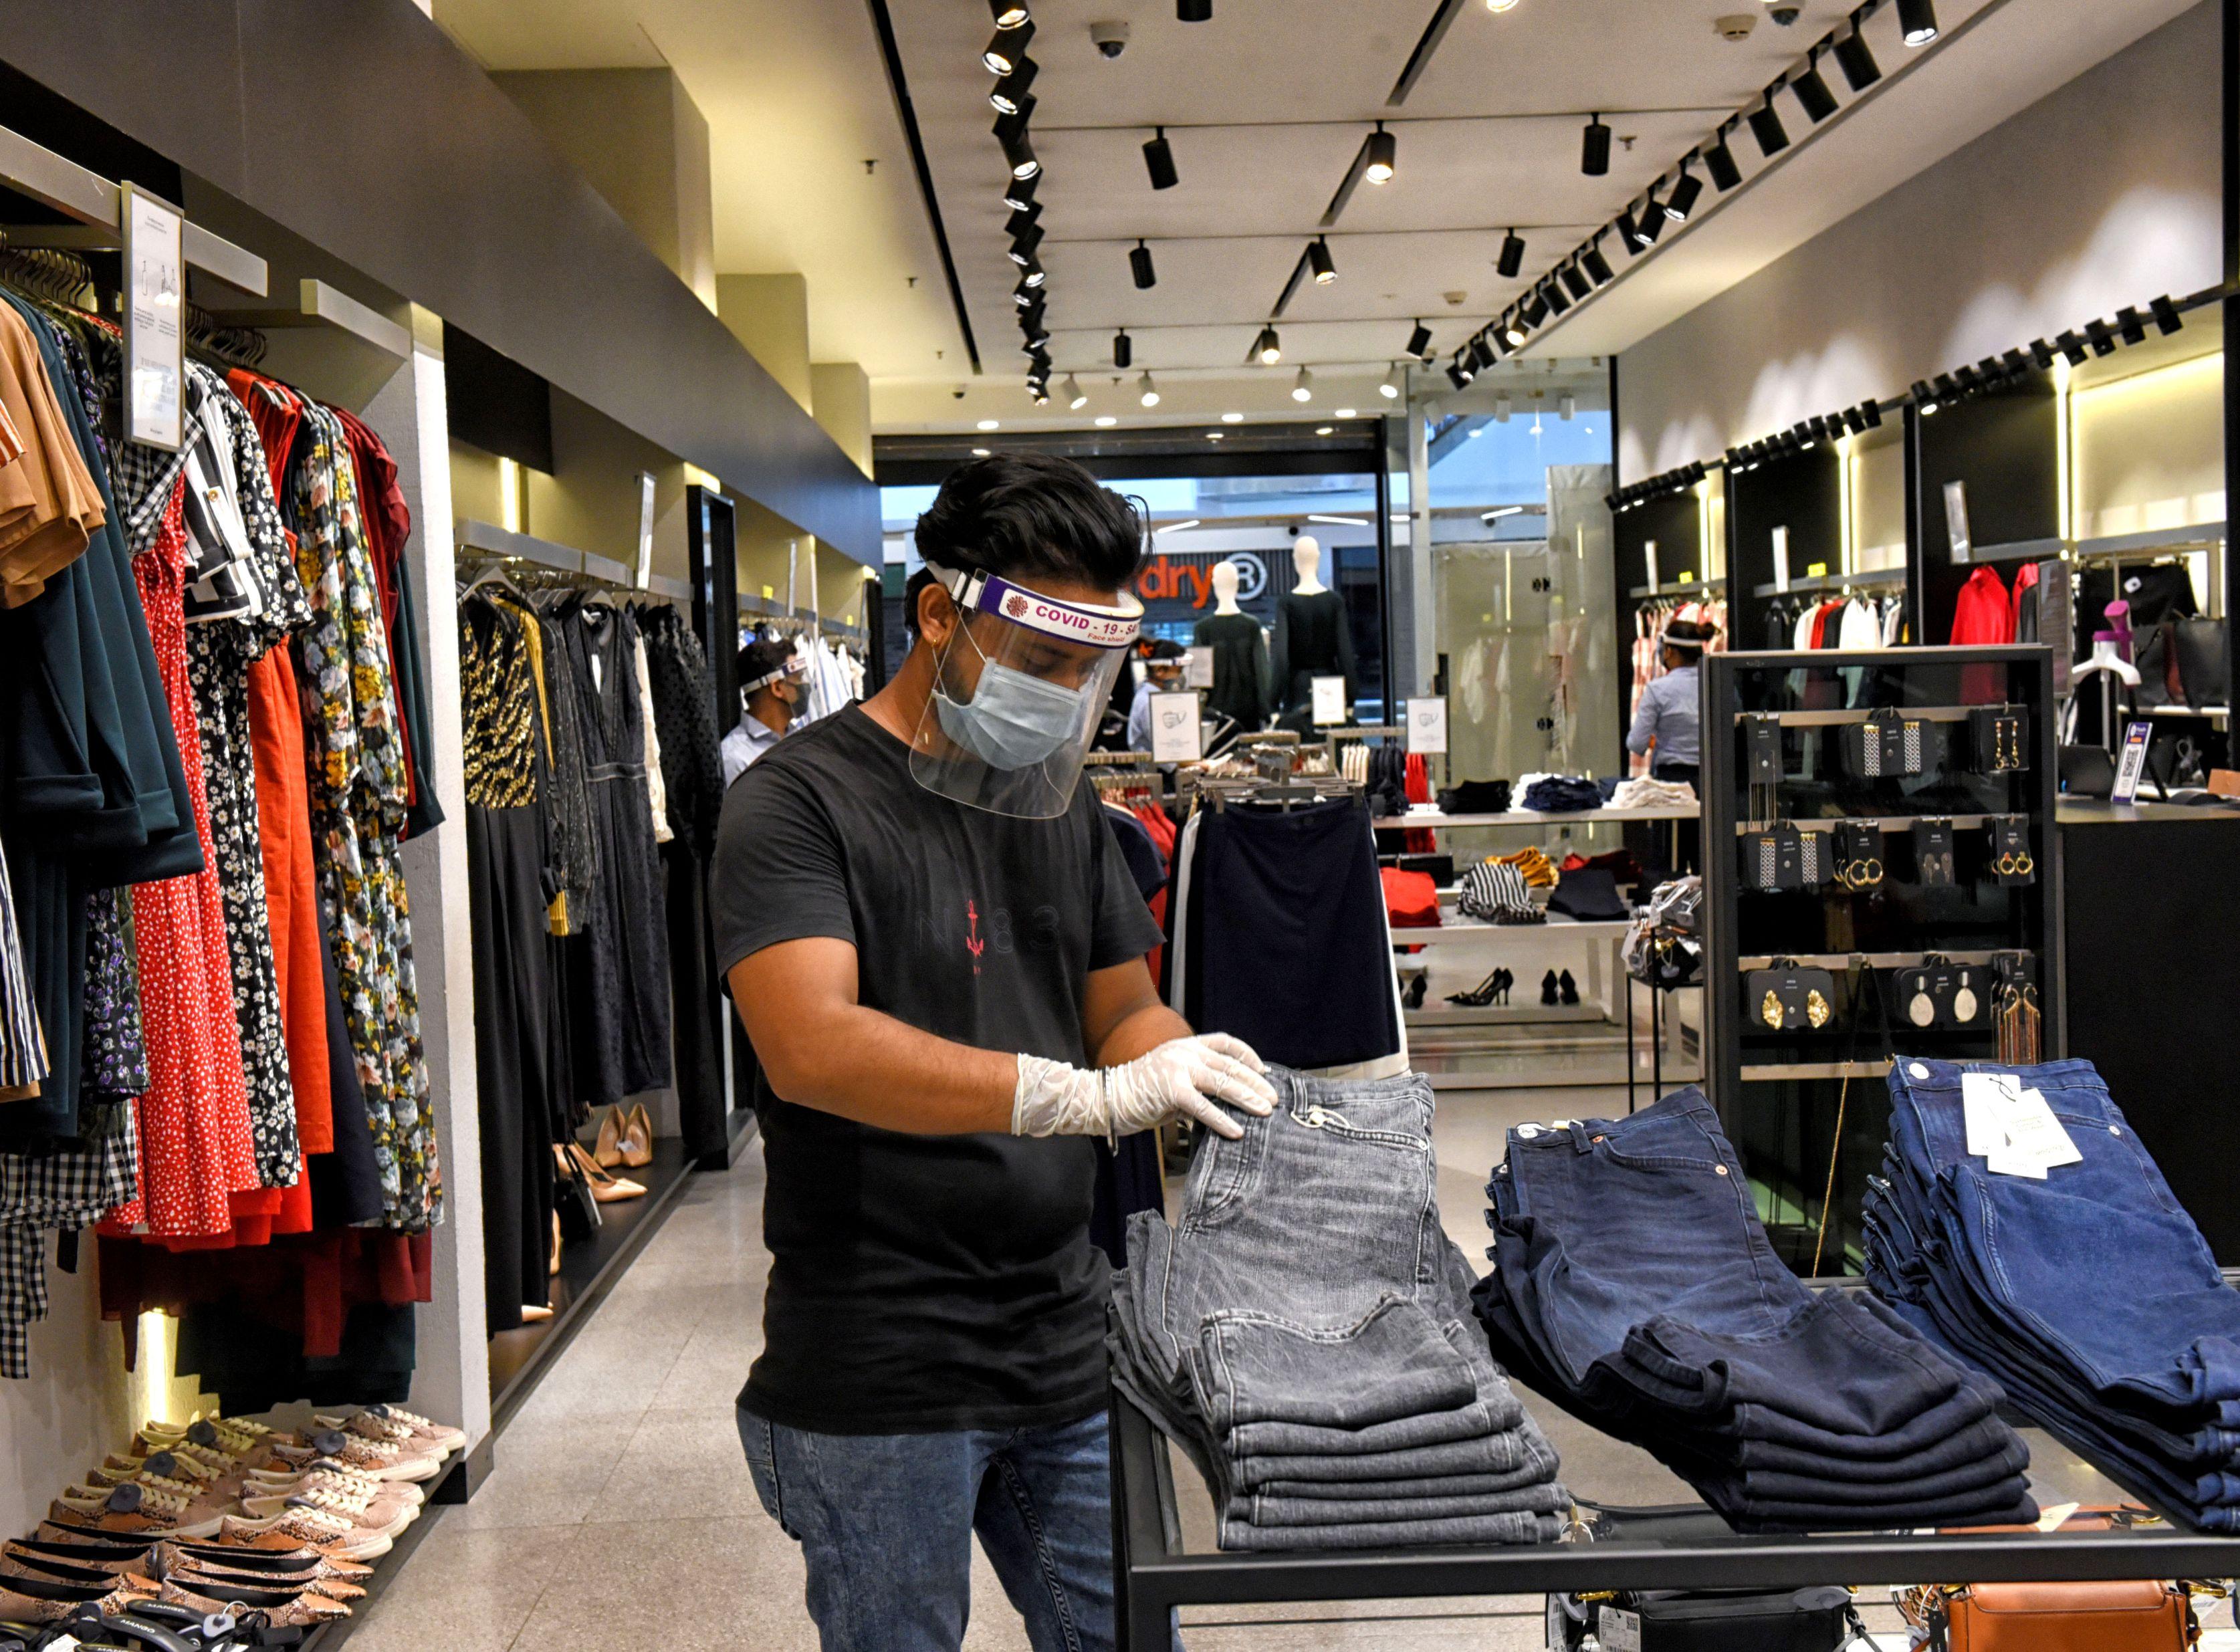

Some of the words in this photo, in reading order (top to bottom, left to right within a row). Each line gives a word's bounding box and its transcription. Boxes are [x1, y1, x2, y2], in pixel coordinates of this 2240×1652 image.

[1137, 556, 1214, 609] dry
[1035, 605, 1090, 630] COVID
[1103, 622, 1118, 635] 19
[1087, 632, 1105, 641] Face
[1107, 634, 1125, 642] shield
[148, 1603, 187, 1613] MANGO
[120, 1619, 156, 1633] MANGO
